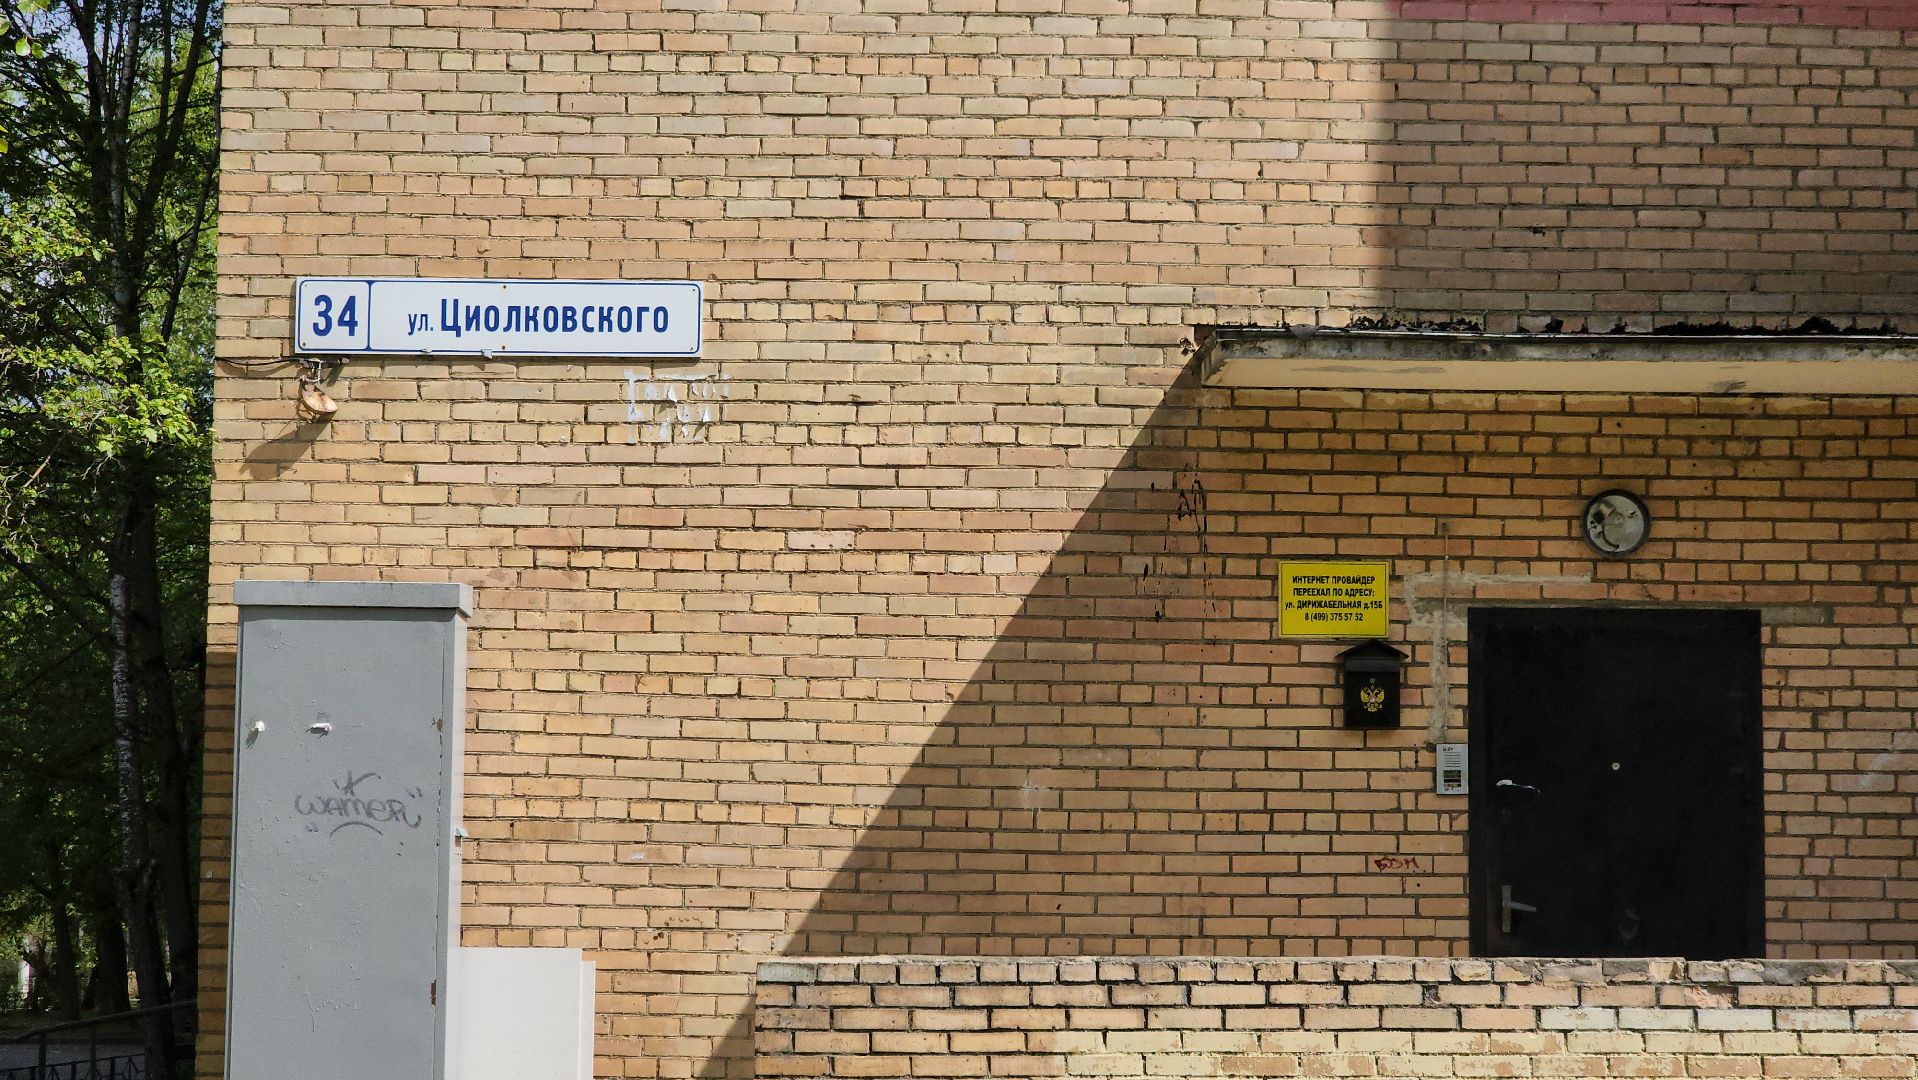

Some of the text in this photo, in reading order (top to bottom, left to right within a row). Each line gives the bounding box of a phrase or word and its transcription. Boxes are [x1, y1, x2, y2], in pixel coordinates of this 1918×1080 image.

[312, 294, 358, 336] 34
[407, 298, 669, 337] ул. Циолковского
[1292, 575, 1375, 586] ИНТЕРНЕТ ПРОВАЙДЕР
[1293, 588, 1375, 597] ПЕРЕЕХАЛ ПО АДРЕСУ:
[1285, 602, 1295, 610] ул.
[1297, 600, 1362, 610] ДИРИЖАБЕЛЬНАЯ
[1304, 613, 1310, 621] 8
[1311, 612, 1328, 622] (499)
[1330, 613, 1343, 621] 375
[1344, 613, 1353, 621] 57
